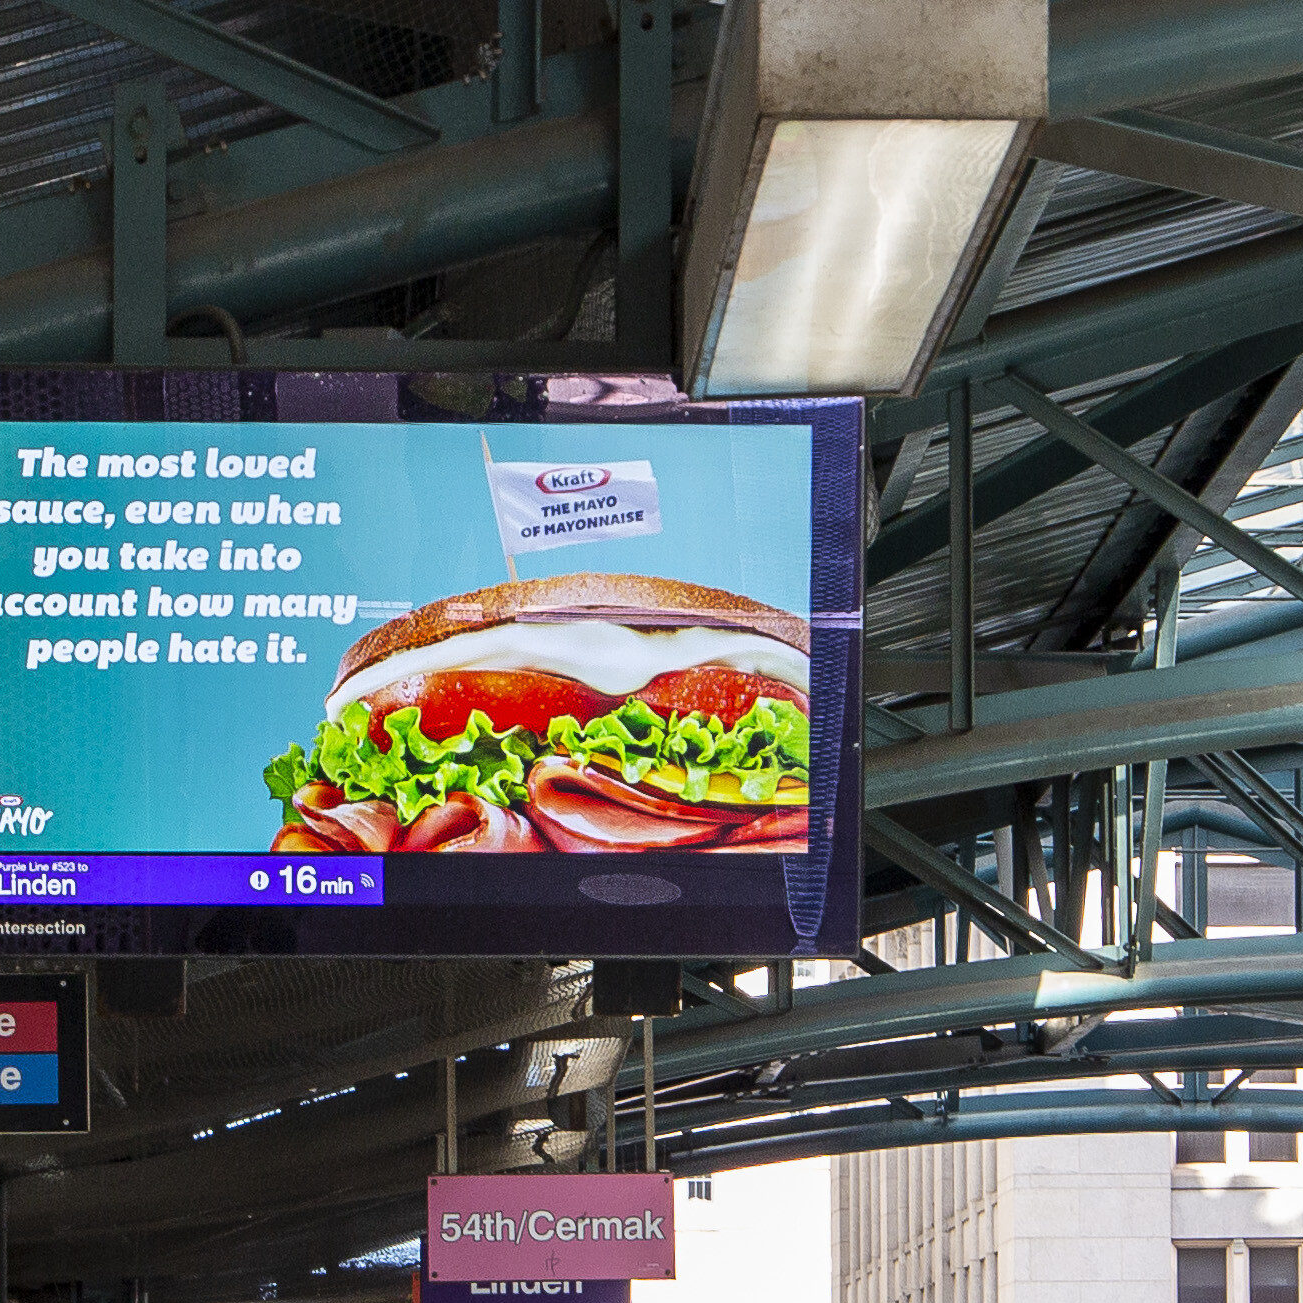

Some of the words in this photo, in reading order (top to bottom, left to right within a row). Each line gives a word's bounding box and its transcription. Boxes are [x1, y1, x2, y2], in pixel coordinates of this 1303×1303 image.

[18, 447, 88, 477] The
[97, 451, 196, 478] most
[206, 448, 316, 478] loved
[552, 470, 595, 488] Kraft
[125, 501, 221, 524] even
[231, 494, 341, 525] when
[541, 503, 571, 517] THE
[574, 496, 618, 512] MAYO
[521, 526, 541, 538] OF
[545, 511, 644, 536] MAYONNAISE
[33, 547, 109, 577] you
[120, 540, 209, 570] take
[220, 540, 301, 571] into
[148, 587, 234, 617] how
[244, 595, 357, 625] many
[26, 633, 159, 669] people
[168, 633, 258, 663] hate
[266, 633, 307, 663] it.
[29, 862, 49, 871] Line
[52, 862, 75, 872] #523
[78, 862, 88, 871] to
[279, 865, 317, 894] 16
[321, 877, 353, 894] min
[441, 1210, 666, 1245] 54th/Cermak
